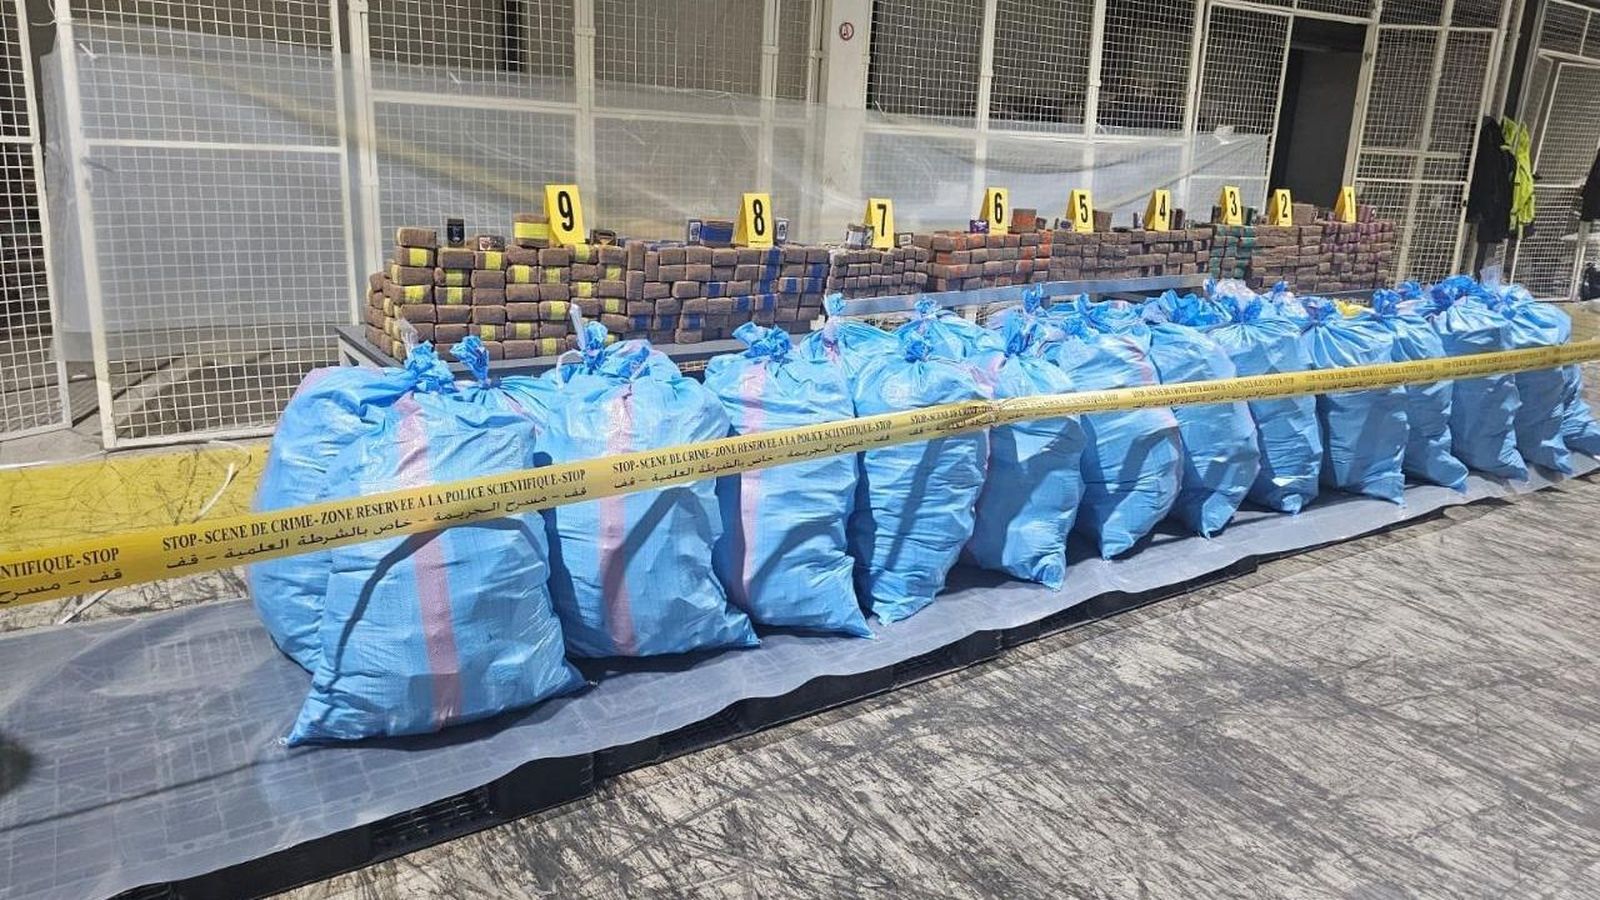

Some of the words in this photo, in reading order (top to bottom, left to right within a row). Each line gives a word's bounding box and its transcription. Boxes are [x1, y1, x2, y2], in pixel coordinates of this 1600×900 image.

[557, 190, 575, 232] 9
[752, 198, 765, 236] 8
[994, 192, 1003, 224] 6
[1079, 194, 1089, 223] 5
[1158, 195, 1167, 222] 4
[1228, 191, 1238, 216] 3
[1280, 193, 1288, 218] 2
[1347, 191, 1354, 215] 1
[876, 203, 888, 237] 7
[669, 452, 681, 464] DE
[251, 522, 269, 537] DE
[356, 497, 416, 519] RESERVEE
[418, 496, 426, 508] A
[427, 493, 443, 506] LA
[445, 485, 486, 504] POLICE
